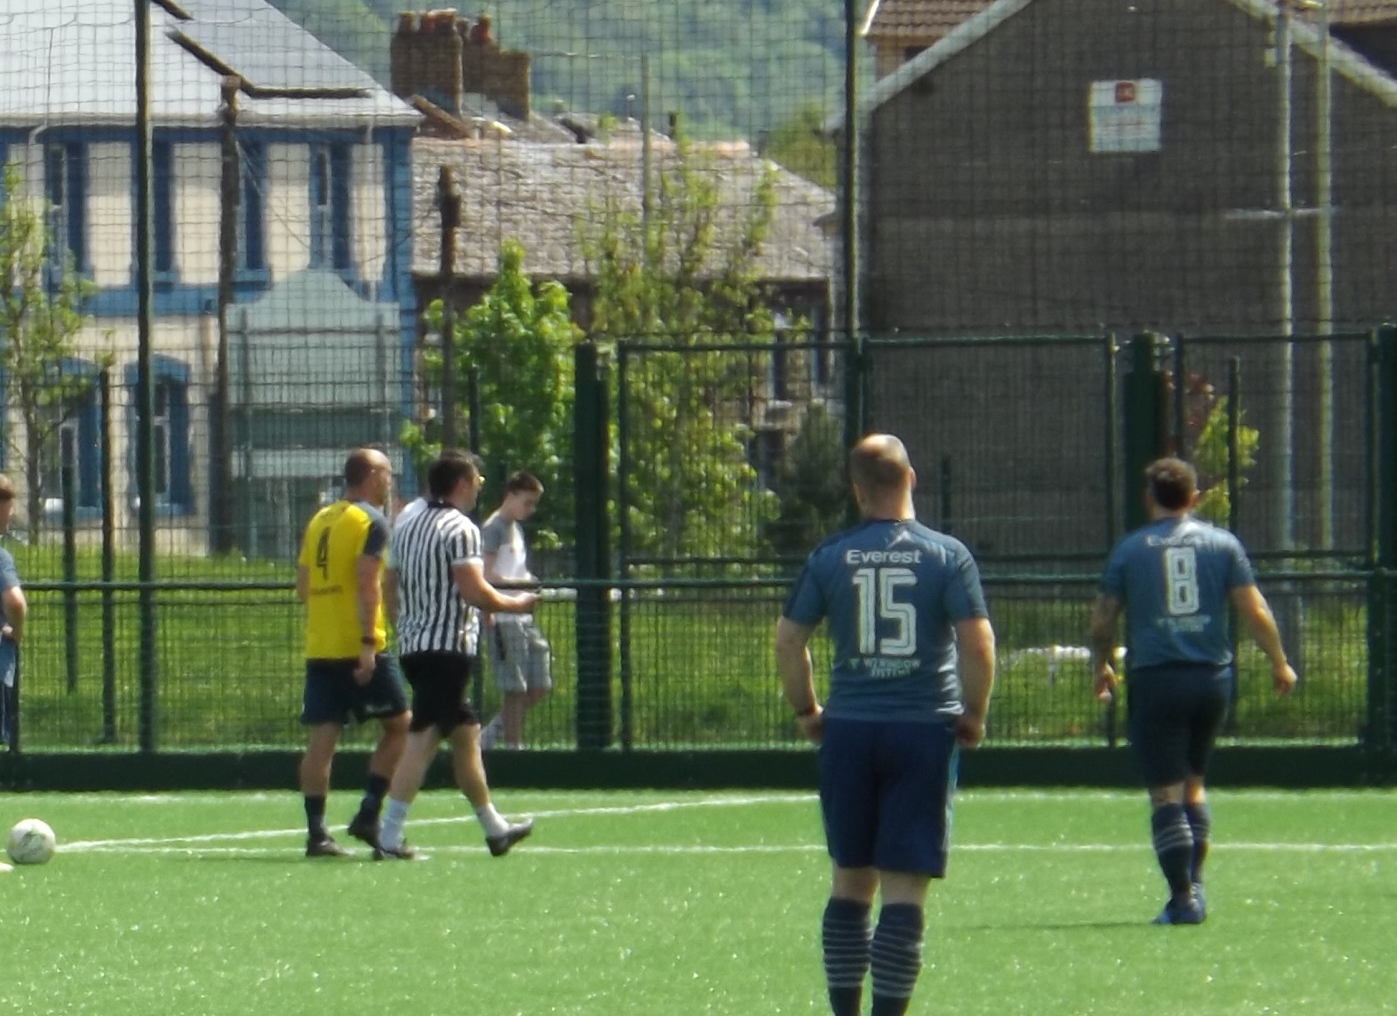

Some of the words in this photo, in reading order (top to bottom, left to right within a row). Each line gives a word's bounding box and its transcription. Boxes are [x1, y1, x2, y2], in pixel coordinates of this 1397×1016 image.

[316, 526, 331, 581] 4
[846, 549, 922, 564] Everest
[1165, 547, 1199, 614] 8
[852, 567, 918, 655] 15
